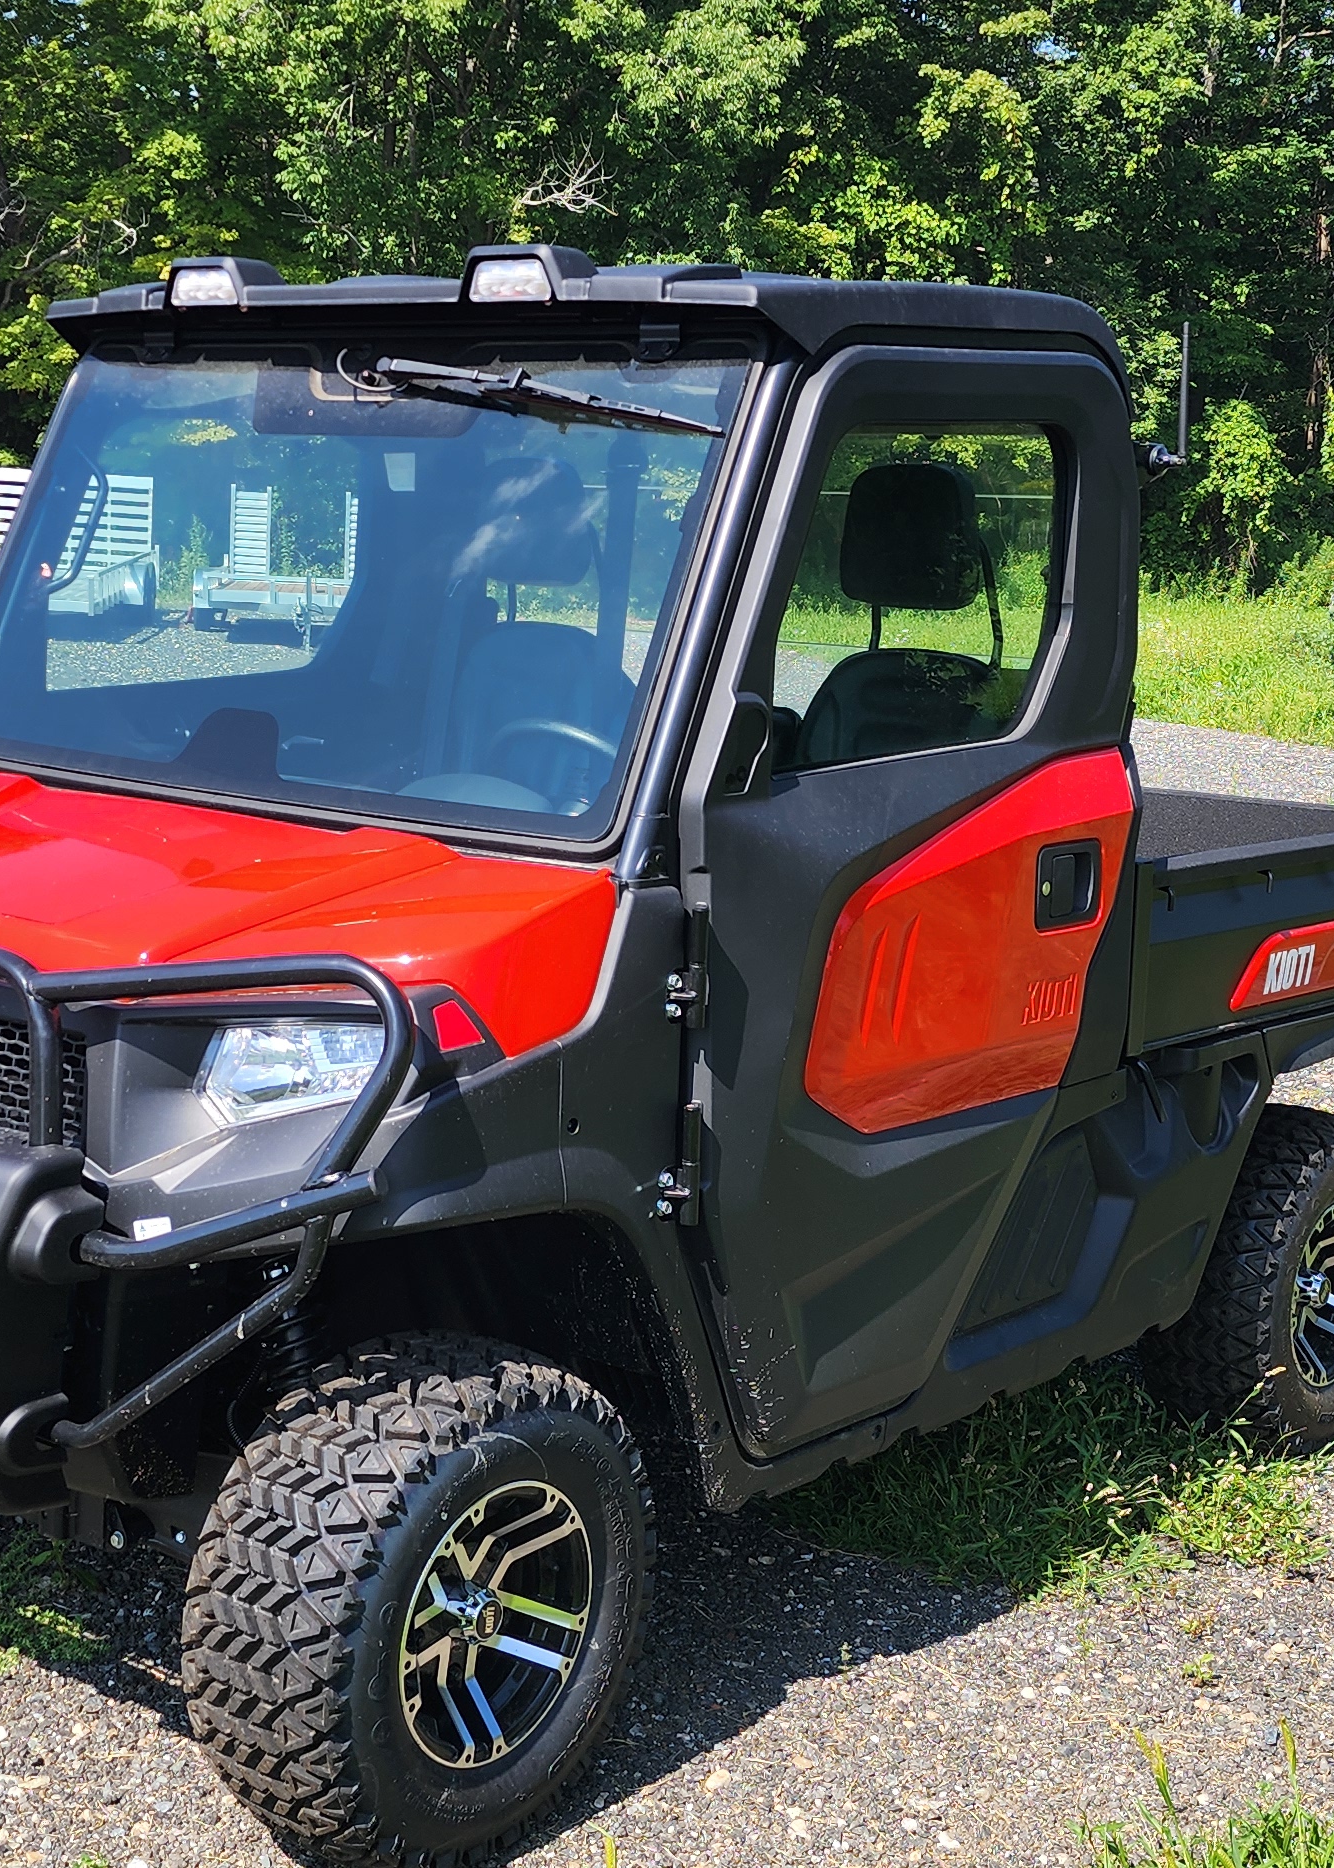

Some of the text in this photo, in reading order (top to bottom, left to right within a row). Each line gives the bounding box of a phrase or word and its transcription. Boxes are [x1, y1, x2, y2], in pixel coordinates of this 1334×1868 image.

[1262, 943, 1316, 996] KIOTI
[1020, 973, 1079, 1026] KIOTI
[484, 1606, 496, 1634] KIOTI
